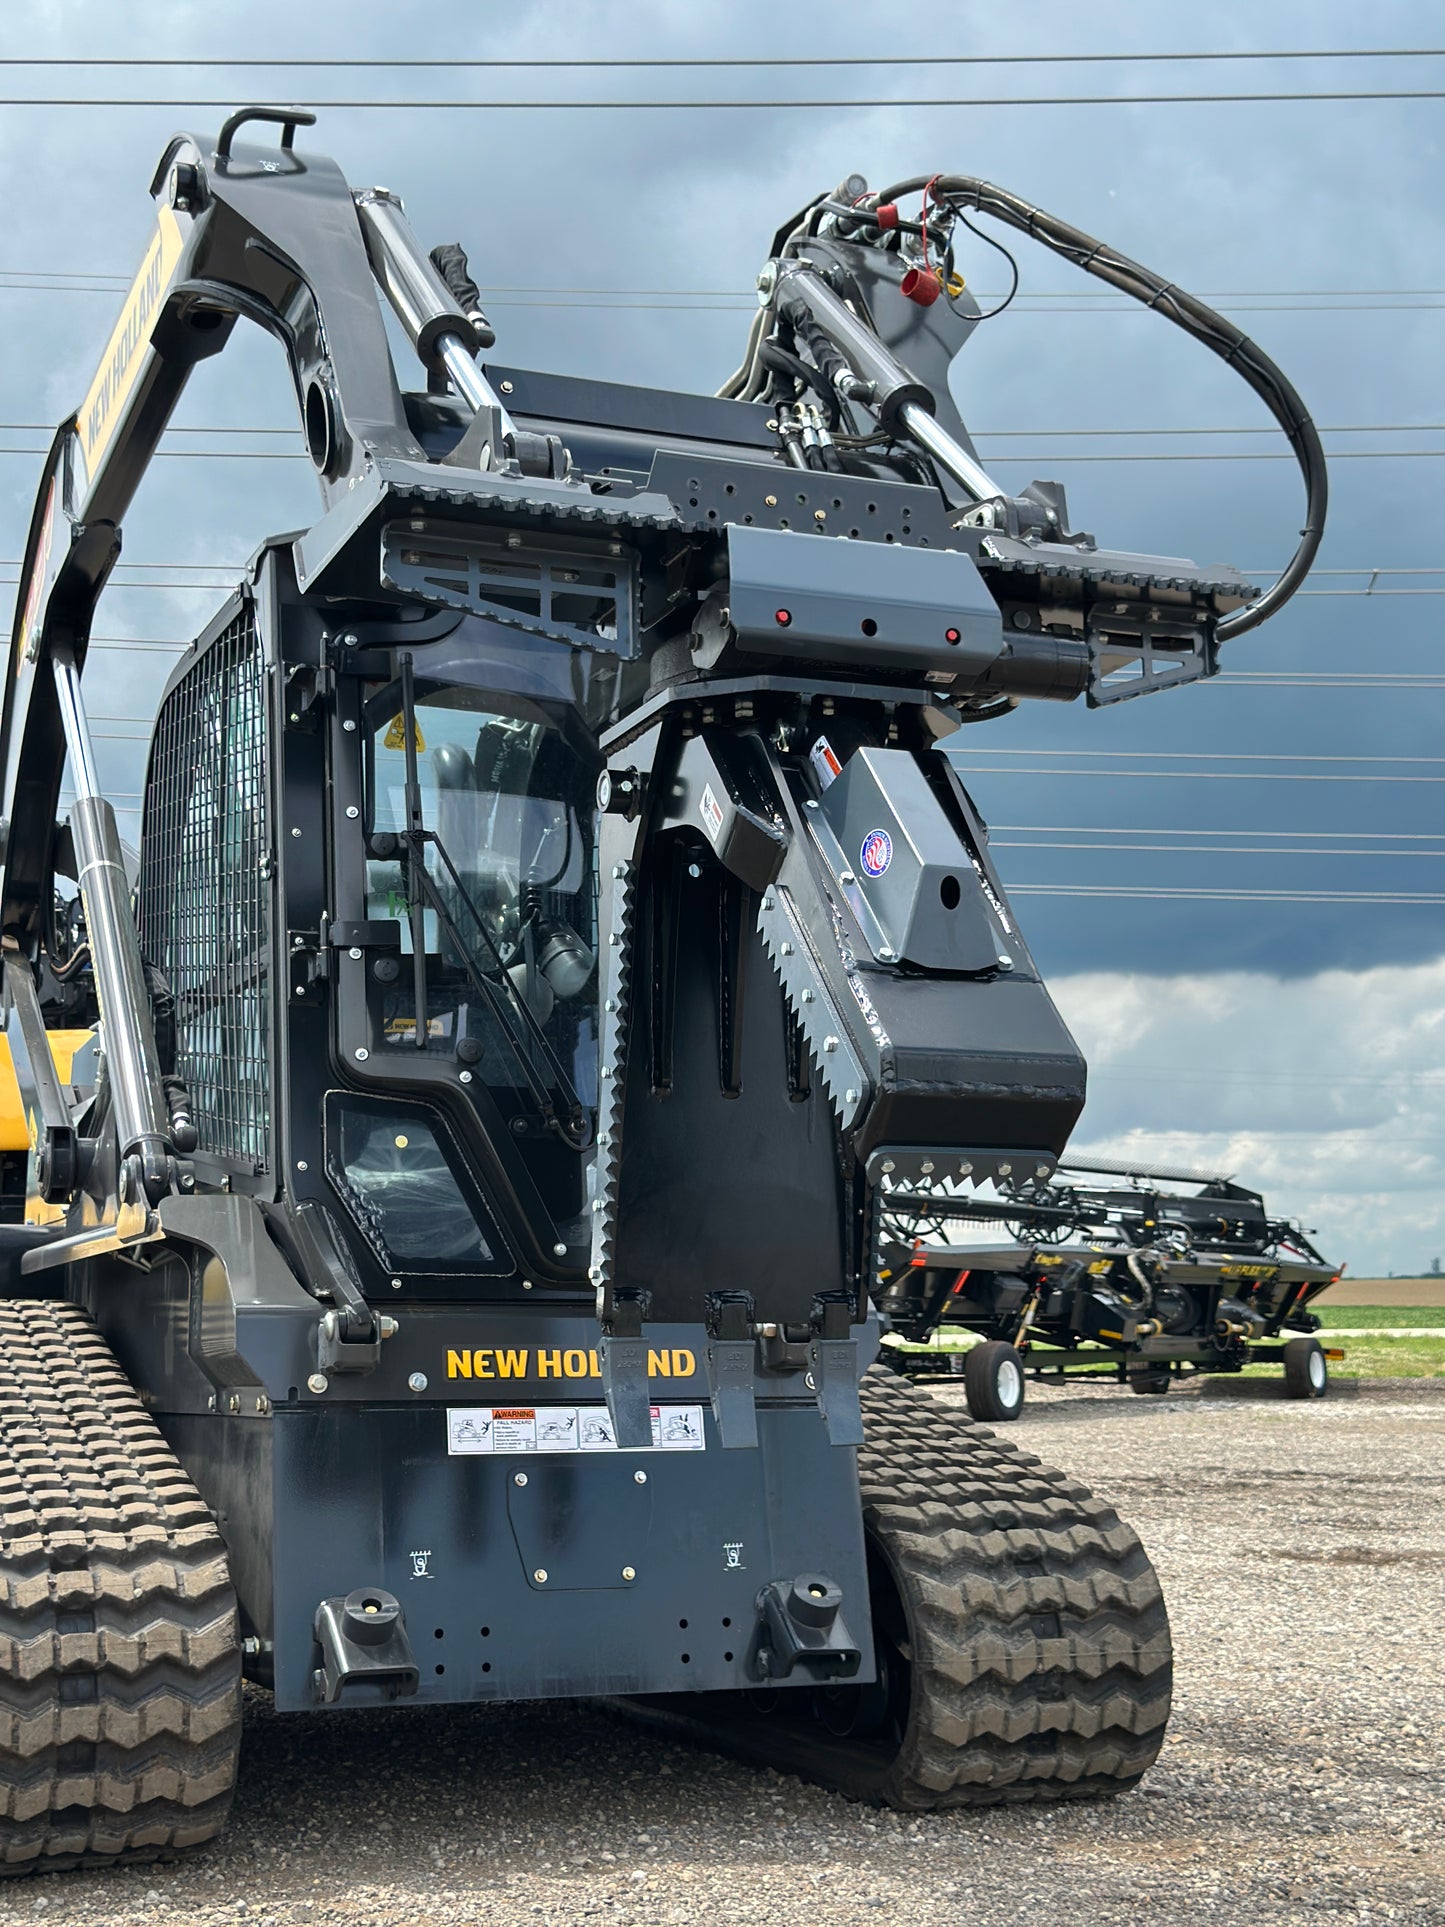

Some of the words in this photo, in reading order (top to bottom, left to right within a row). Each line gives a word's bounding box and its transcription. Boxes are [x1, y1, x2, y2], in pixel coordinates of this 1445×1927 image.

[88, 366, 111, 454] NEW
[111, 251, 163, 399] HOLLAND
[447, 1349, 528, 1378] NEW
[537, 1349, 697, 1378] HOLND
[501, 1410, 534, 1418] WARNING
